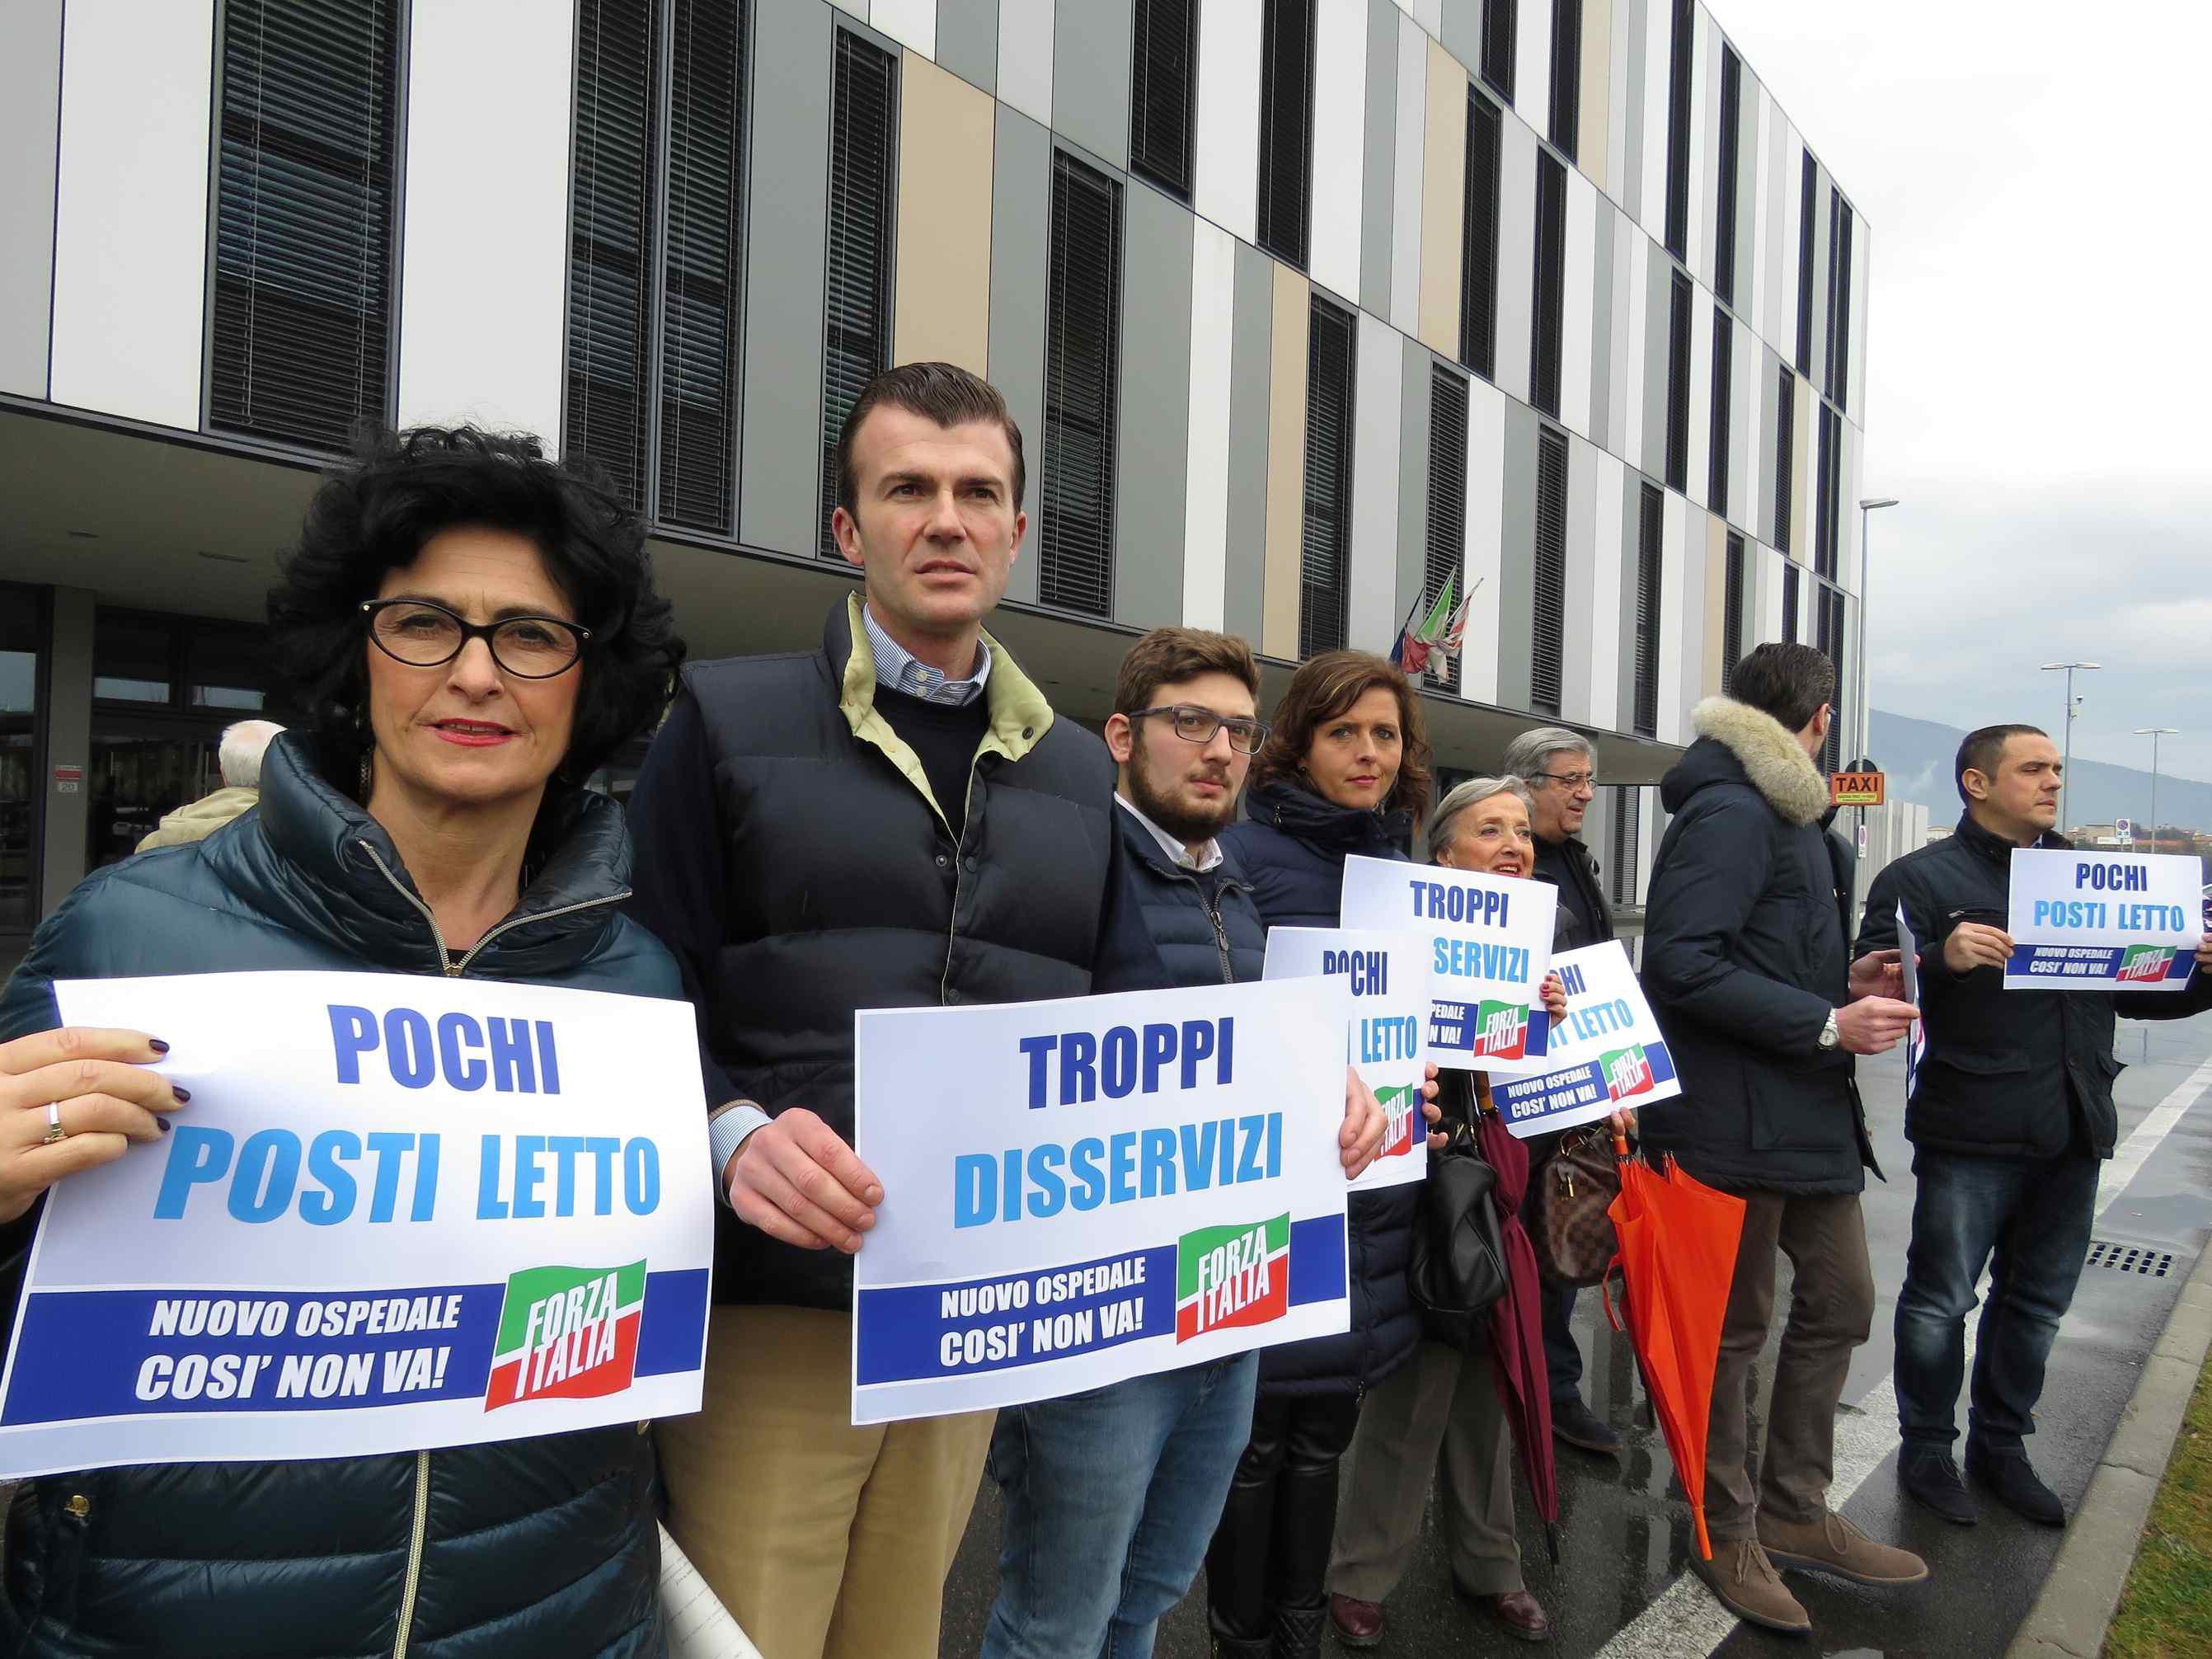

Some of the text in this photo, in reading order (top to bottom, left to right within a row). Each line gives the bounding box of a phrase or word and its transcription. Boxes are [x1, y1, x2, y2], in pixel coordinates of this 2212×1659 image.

[1836, 778, 1877, 792] TAXI
[2076, 863, 2147, 891] POCHI
[1410, 881, 1509, 928] TROPPI
[2034, 900, 2185, 932] POSTI LETTO
[2034, 947, 2114, 959] NUOVO OSPEDALE
[2062, 962, 2088, 975] NON
[2088, 963, 2109, 975] VA!
[2125, 961, 2161, 980] ITALIA
[2130, 948, 2166, 969] FORZA
[1361, 1015, 1417, 1064] LETTO
[1441, 1026, 1463, 1045] VA!
[1483, 1027, 1518, 1055] ITALIA
[1486, 1007, 1518, 1034] FORZA
[1570, 999, 1634, 1041] LETTO
[327, 1003, 561, 1095] POCHI
[1019, 1017, 1234, 1109] TROPPI
[1609, 1048, 1638, 1079] FORZA
[1507, 1065, 1593, 1099] NUOVO OSPEDALE
[1511, 1083, 1598, 1119] COSI' NON VA!
[1614, 1063, 1646, 1098] ITALIA
[153, 1125, 660, 1225] POSTI LETTO
[954, 1112, 1283, 1229] DISSERVIZI
[1198, 1224, 1267, 1293] FORZA
[941, 1257, 1146, 1319] NUOVO OSPEDALE
[1196, 1262, 1270, 1332] ITALIA
[148, 1294, 463, 1337] NUOVO OSPEDALE
[523, 1271, 618, 1351] FORZA
[940, 1296, 1144, 1367] COSI' NON VA!
[135, 1346, 452, 1401] COSI' NON VA!
[514, 1318, 618, 1400] ITALIA
